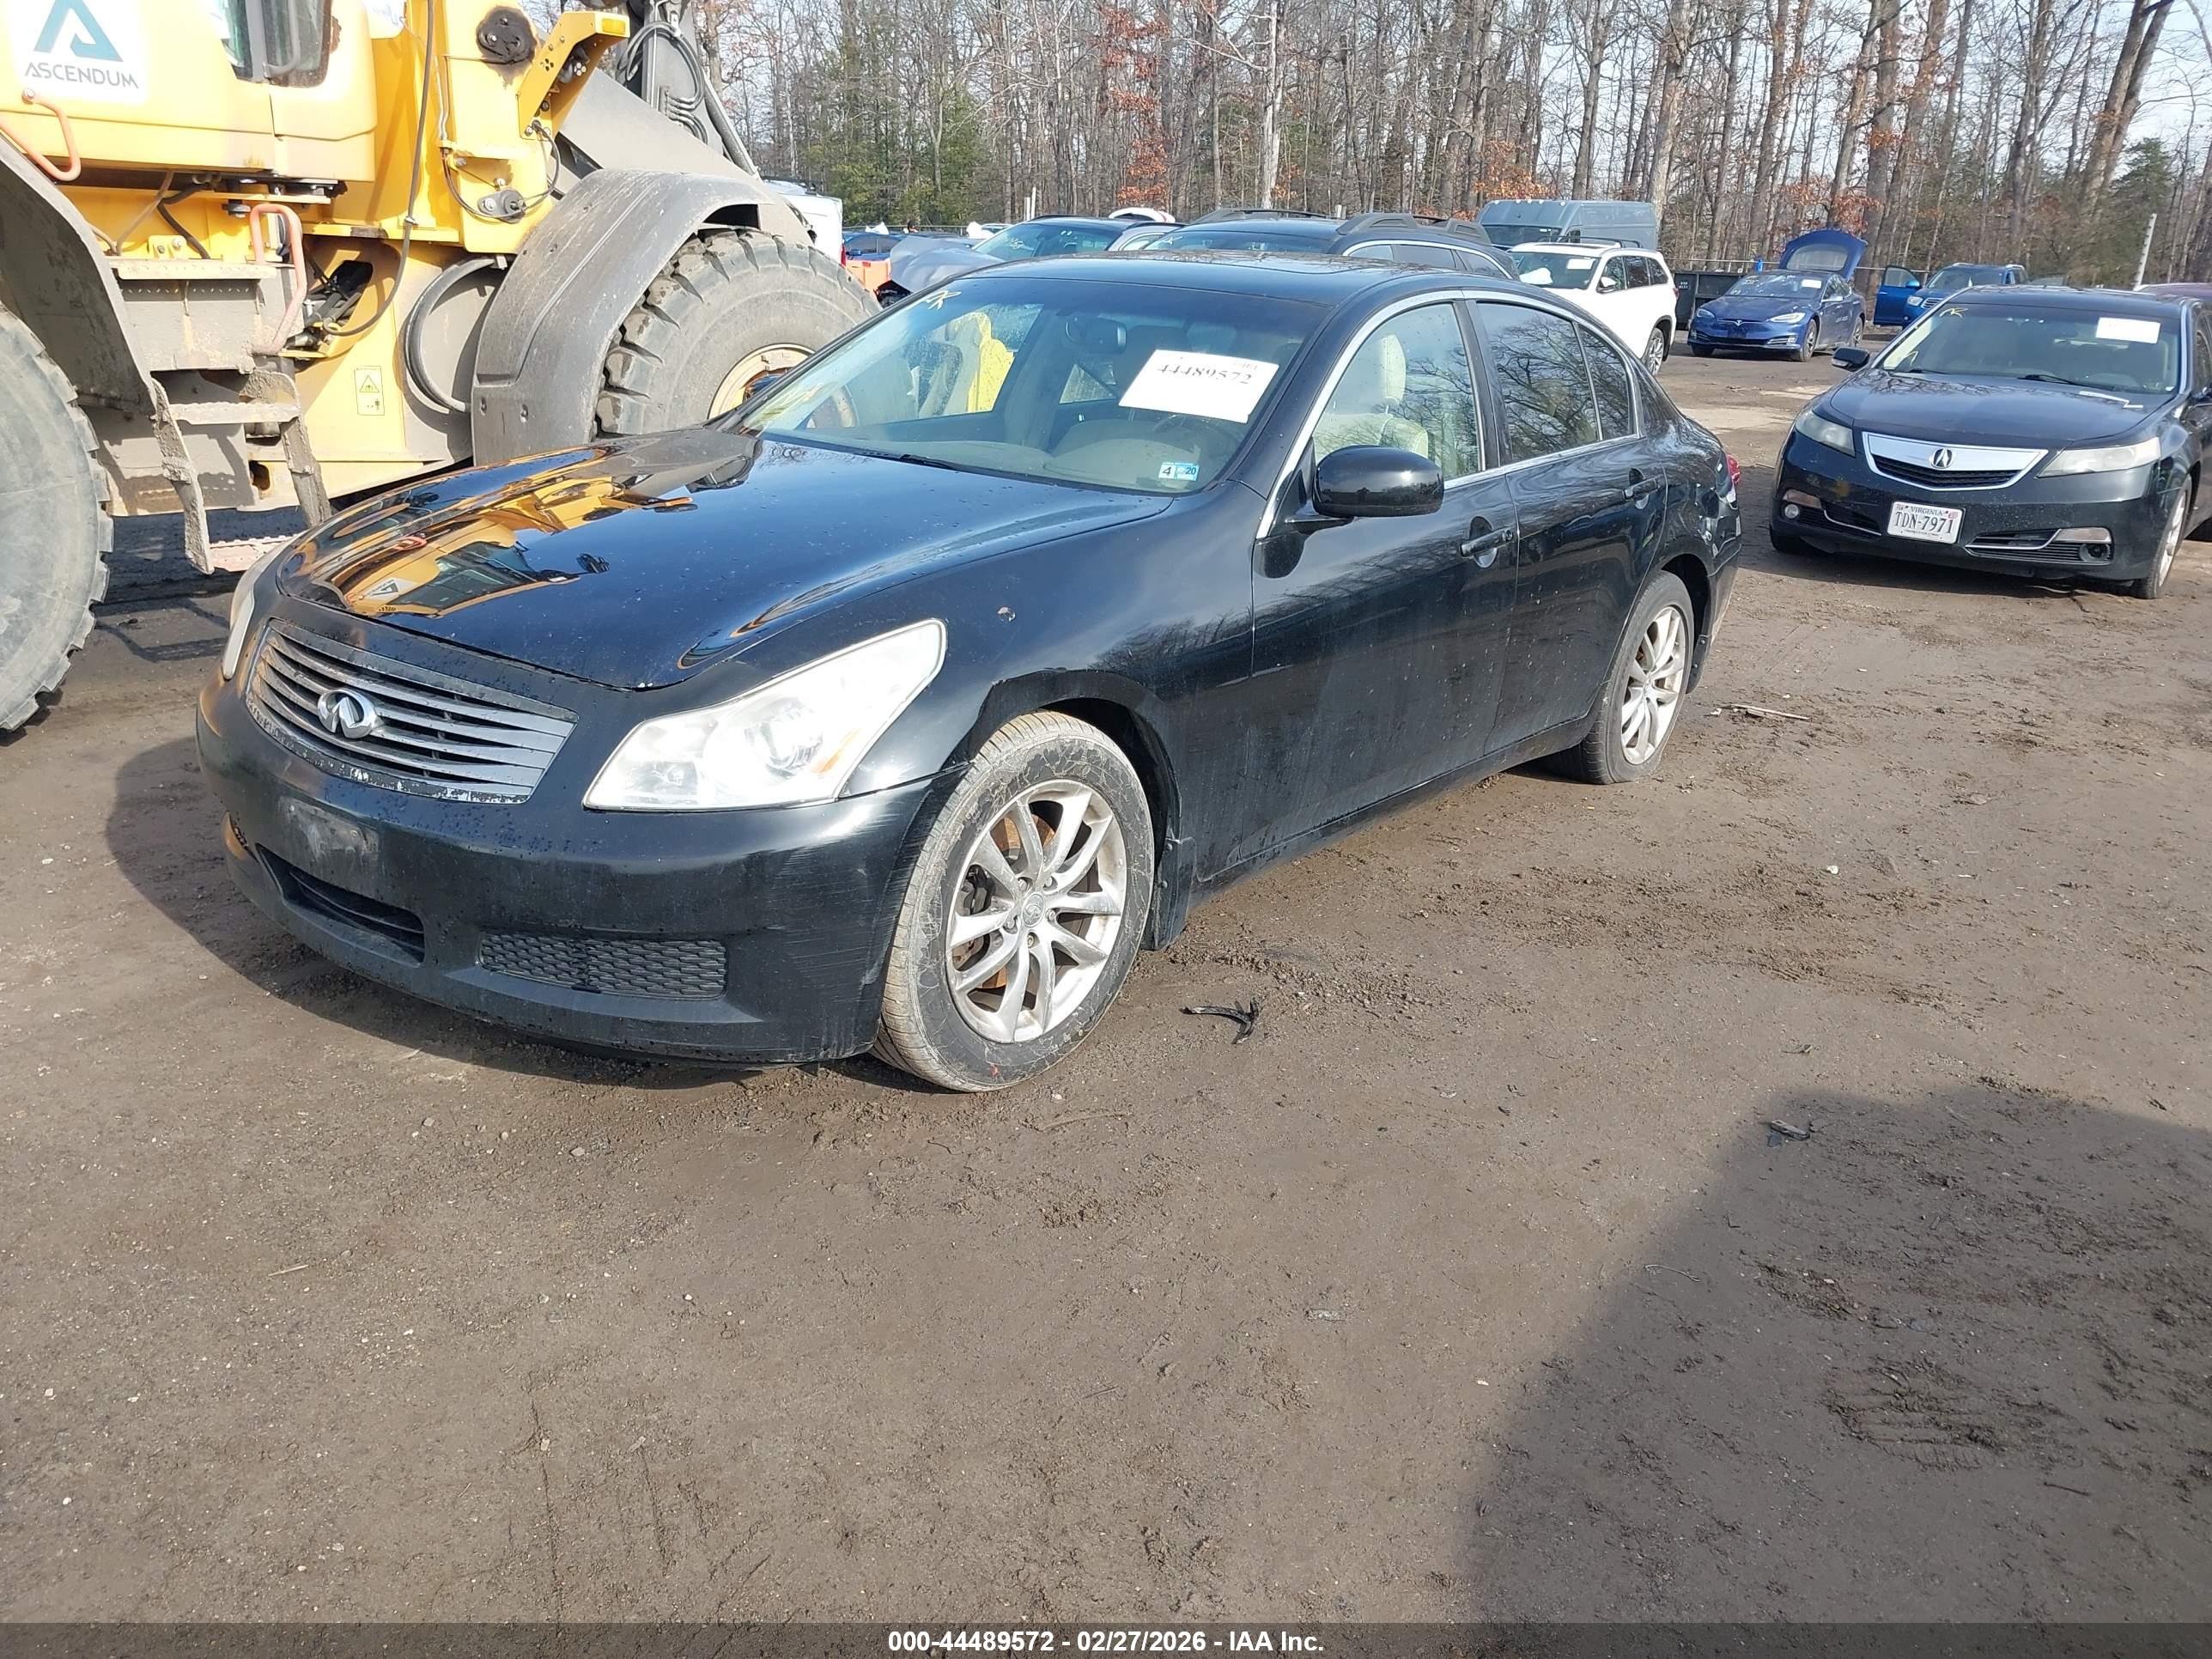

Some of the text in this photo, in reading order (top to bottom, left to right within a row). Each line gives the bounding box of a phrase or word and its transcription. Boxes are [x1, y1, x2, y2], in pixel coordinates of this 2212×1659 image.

[24, 61, 139, 89] ASCENDUM
[1158, 363, 1253, 385] 44489572
[1162, 466, 1197, 476] 4 20
[1894, 511, 1954, 533] TDN-7971
[1910, 506, 1943, 516] VIRGINIA
